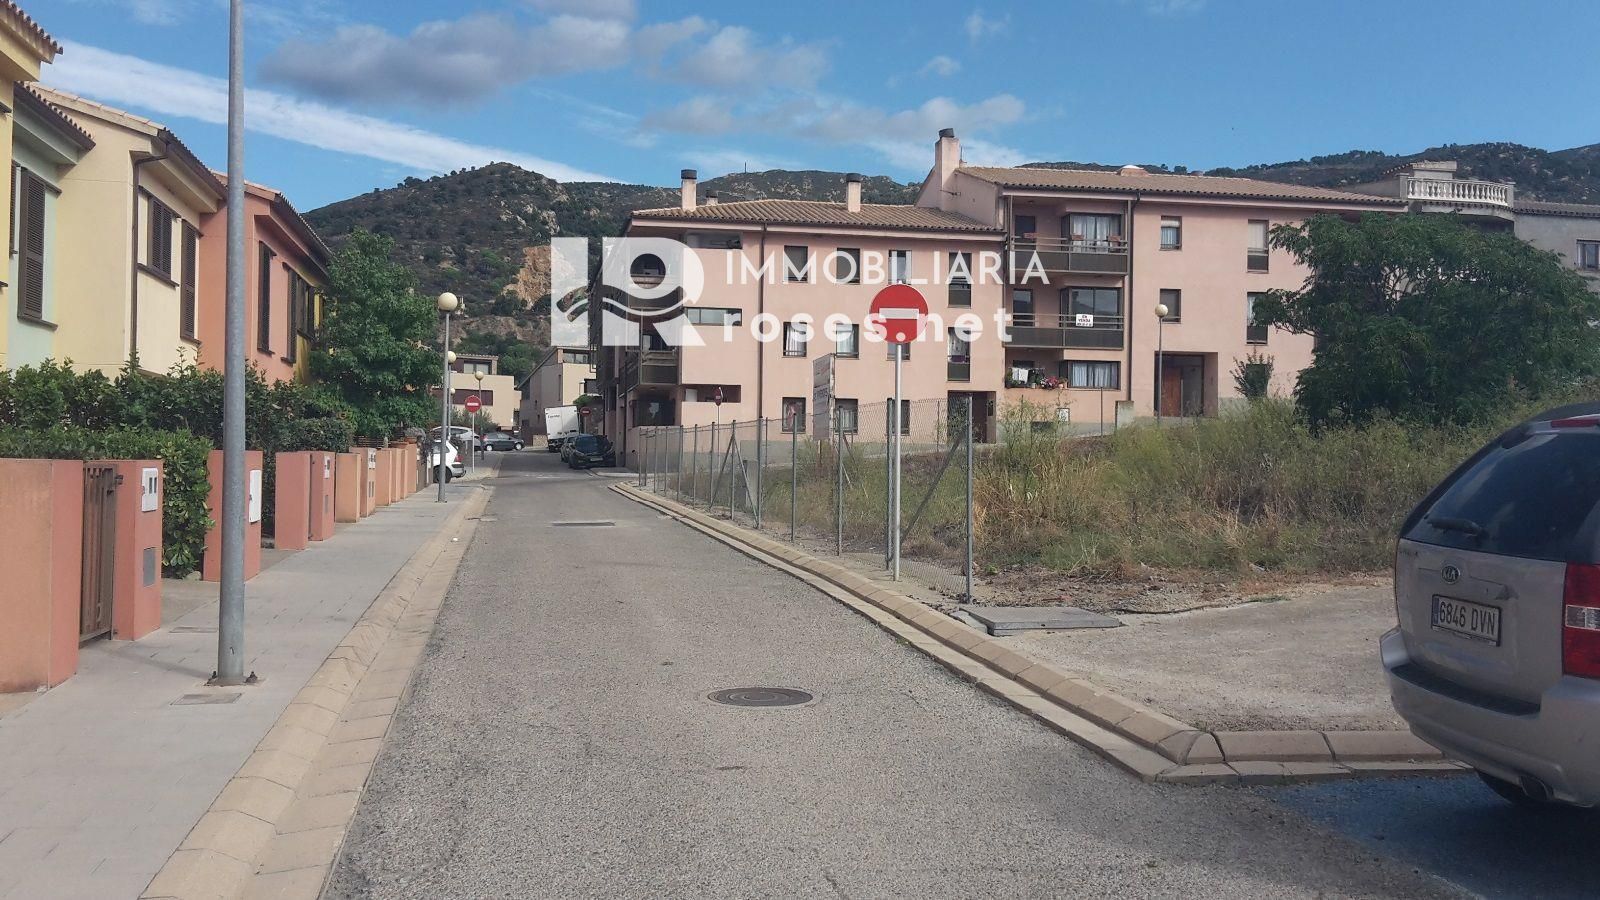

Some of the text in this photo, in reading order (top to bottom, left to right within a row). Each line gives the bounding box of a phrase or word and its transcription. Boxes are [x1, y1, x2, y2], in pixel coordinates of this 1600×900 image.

[1442, 567, 1459, 581] KIA
[1439, 601, 1496, 636] 6846 DVN
